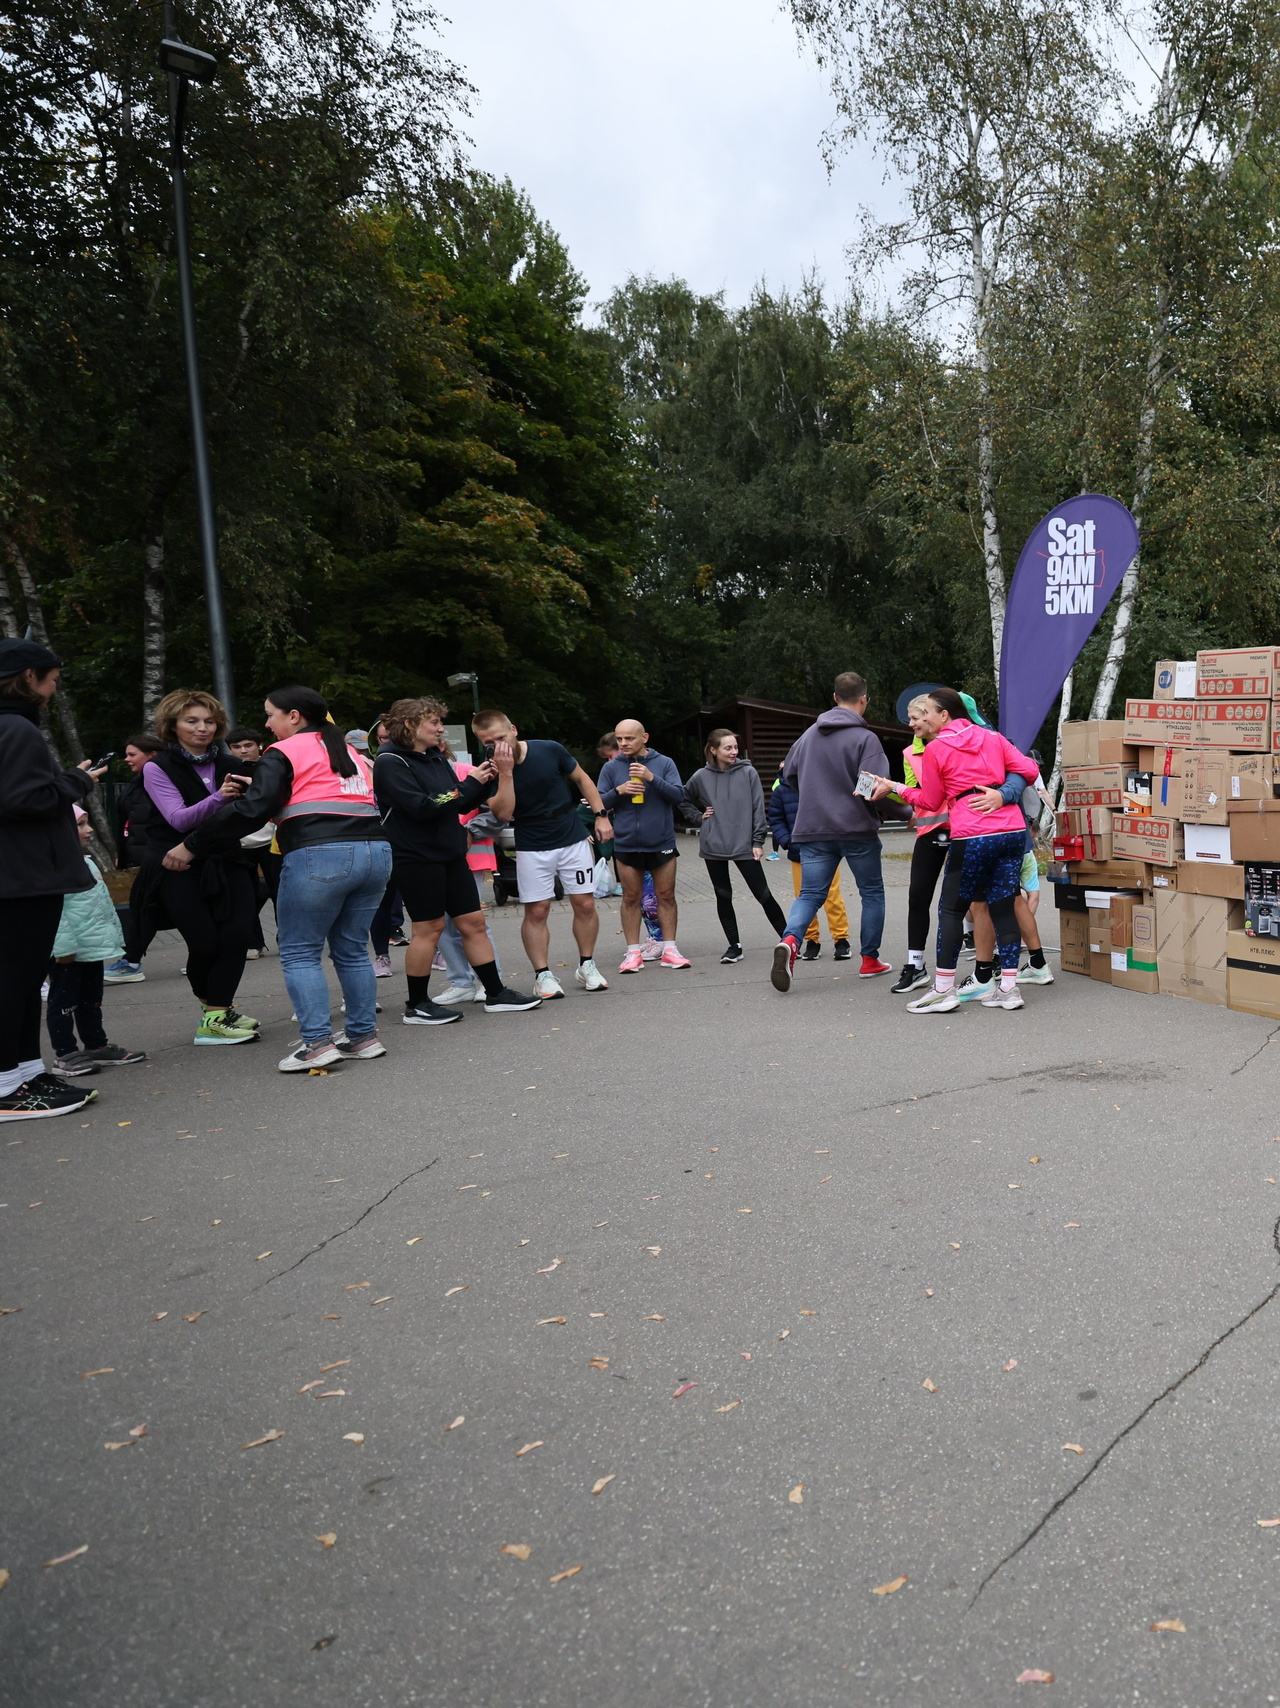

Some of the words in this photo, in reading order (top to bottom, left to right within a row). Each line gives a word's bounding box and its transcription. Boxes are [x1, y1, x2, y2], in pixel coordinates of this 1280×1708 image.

[1048, 517, 1096, 556] Sat
[1047, 556, 1095, 585] 9AM
[1045, 585, 1094, 616] 5KM
[575, 867, 593, 885] 07
